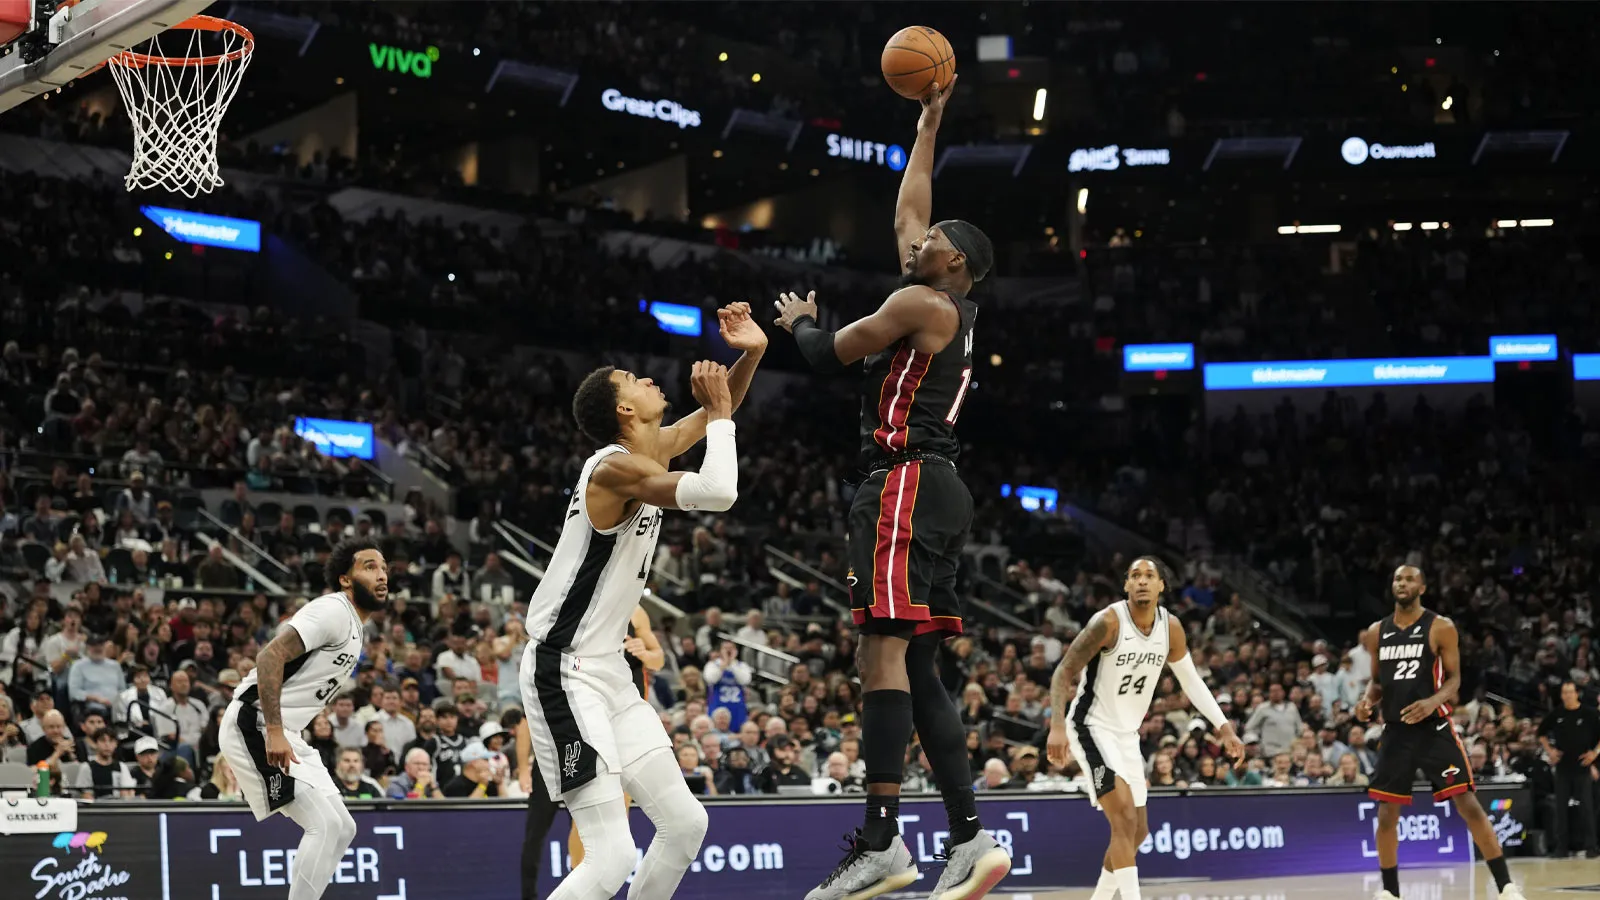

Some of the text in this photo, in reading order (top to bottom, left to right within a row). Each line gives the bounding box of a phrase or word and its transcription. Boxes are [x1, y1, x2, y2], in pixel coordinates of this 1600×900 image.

[369, 43, 431, 78] viva
[1116, 652, 1164, 670] SPURS
[1379, 644, 1424, 661] MIAMI
[1393, 660, 1420, 681] 22
[719, 685, 741, 704] 32
[1117, 675, 1148, 696] 24
[1137, 821, 1285, 860] edger.com
[1372, 814, 1442, 842] DGER
[30, 852, 102, 900] South
[238, 847, 380, 886] LEER
[58, 865, 130, 900] Padre
